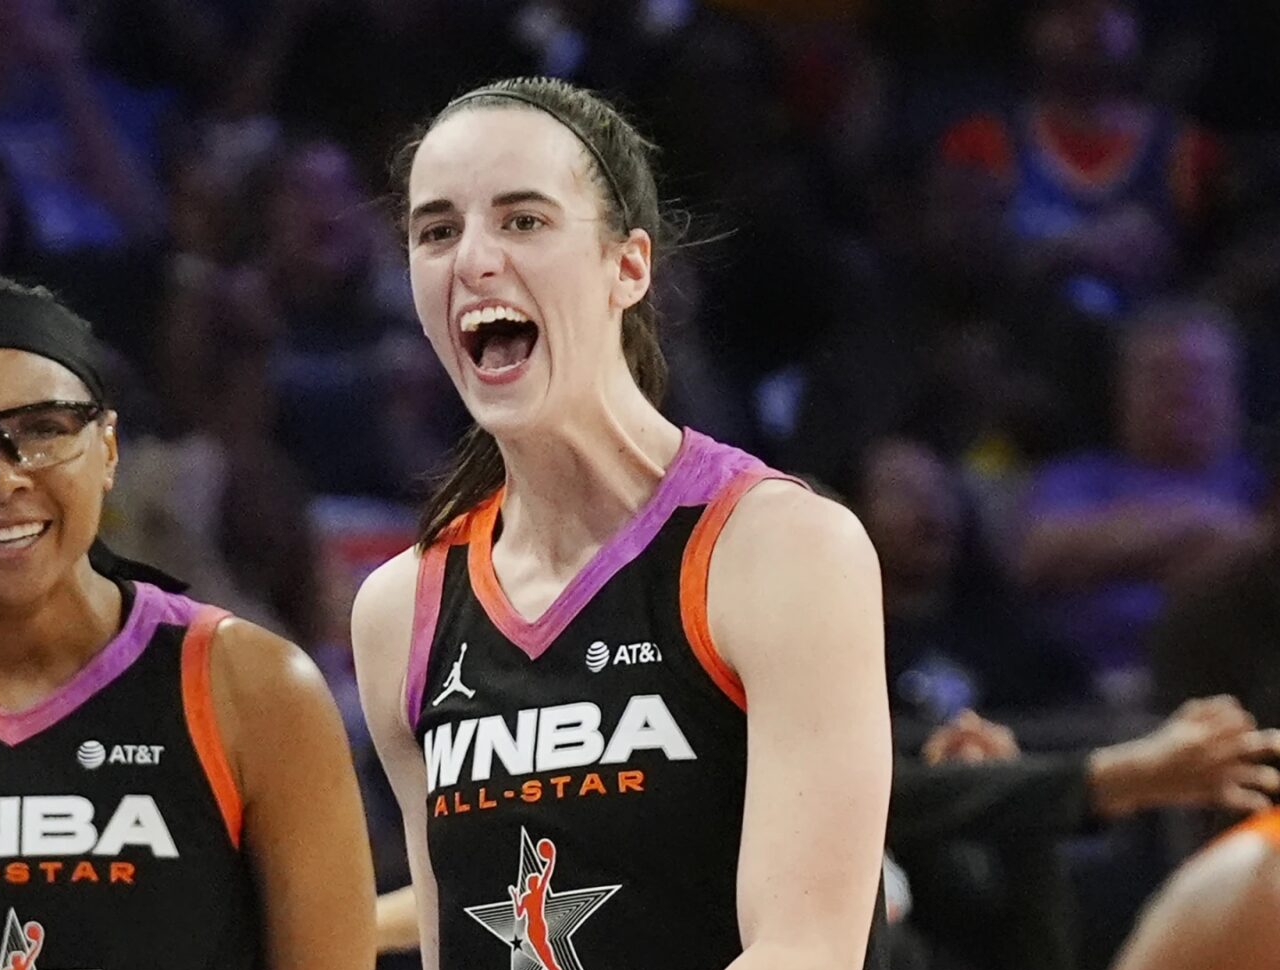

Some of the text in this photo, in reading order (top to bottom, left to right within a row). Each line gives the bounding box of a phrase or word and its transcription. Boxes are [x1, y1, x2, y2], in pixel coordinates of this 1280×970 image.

[109, 745, 164, 764] AT&T
[424, 694, 697, 792] WNBA
[435, 771, 643, 815] ALL-STAR
